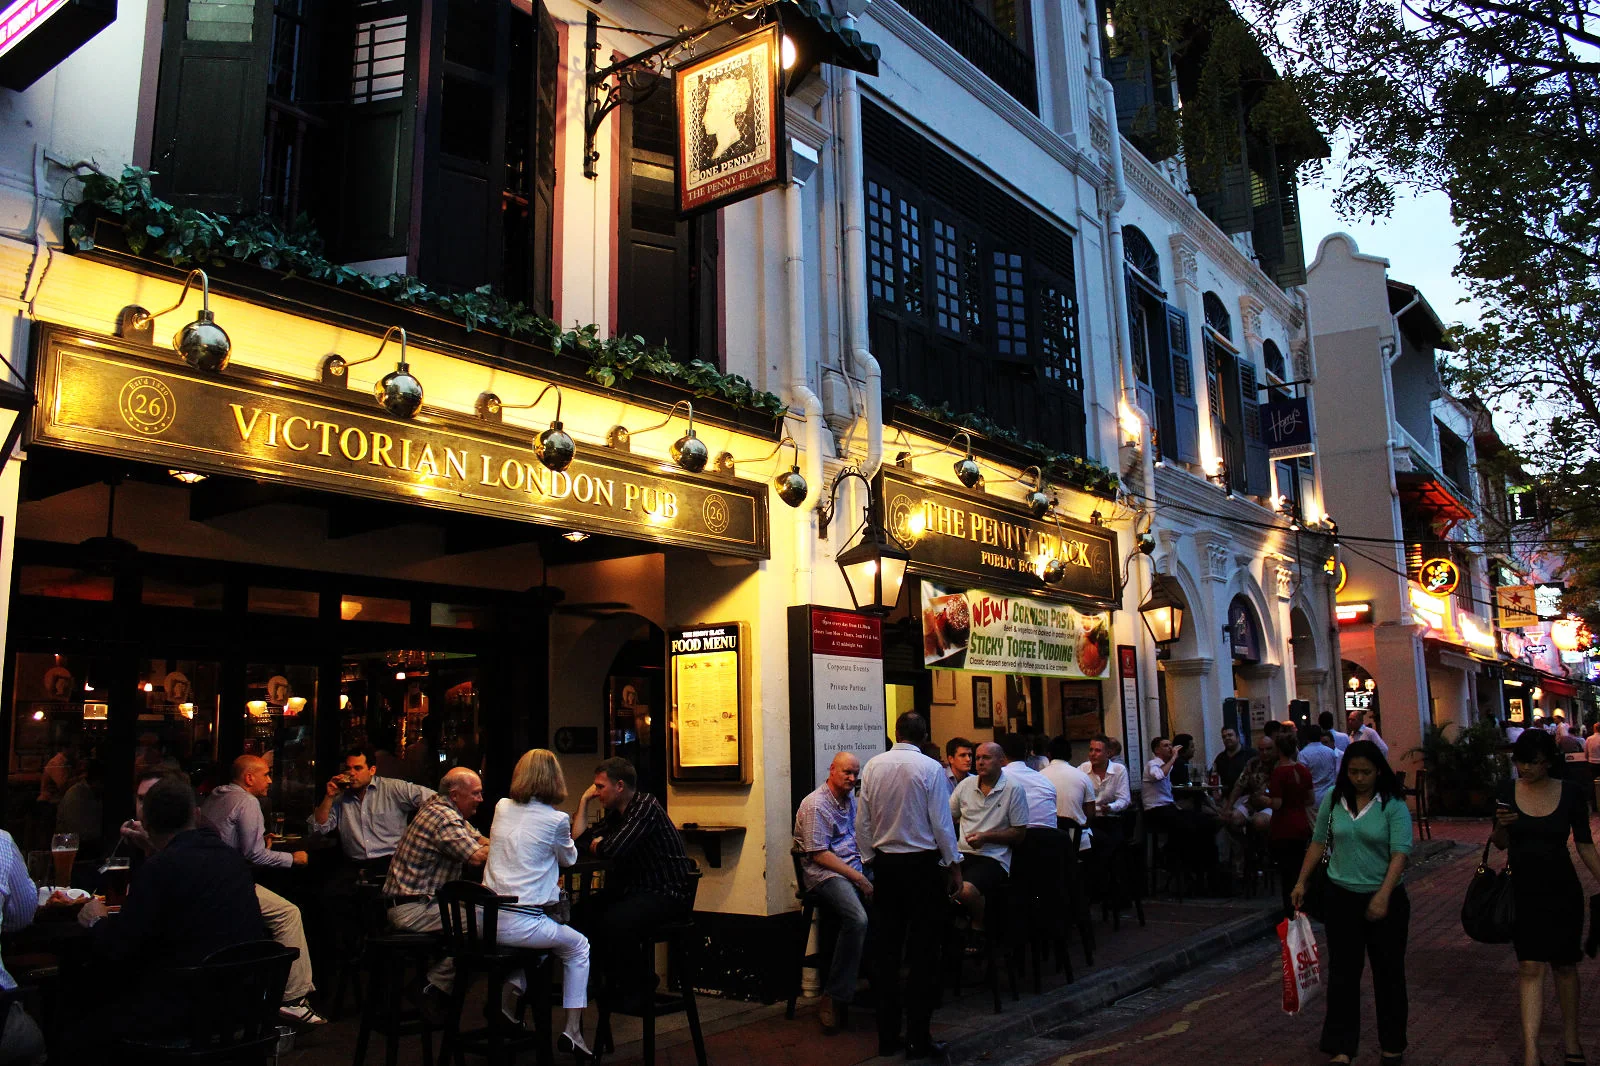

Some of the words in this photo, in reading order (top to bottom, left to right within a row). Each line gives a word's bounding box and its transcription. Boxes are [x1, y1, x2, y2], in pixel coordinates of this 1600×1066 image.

[702, 56, 750, 82] POSTAGE
[700, 164, 719, 180] ONE
[688, 185, 705, 201] THE
[707, 176, 737, 193] PENNY
[739, 163, 771, 181] BLACK
[135, 394, 160, 416] 26
[1269, 408, 1302, 442] Harry's
[229, 403, 468, 480] VICTORIAN
[480, 454, 614, 507] LONDON
[623, 482, 678, 518] PUB
[710, 506, 722, 521] 26
[923, 500, 965, 539] THE
[969, 512, 1033, 555] PENNY
[1037, 531, 1091, 568] BLACK
[981, 550, 1015, 571] PUBLIC
[972, 597, 1009, 629] NEW!
[709, 628, 725, 636] BLACK
[1003, 624, 1013, 632] Beef
[671, 638, 701, 653] FOOD
[703, 635, 736, 650] MENU
[970, 632, 1003, 656] STICKY
[1007, 635, 1037, 659] TOFFEE
[1038, 640, 1073, 663] PUDDING
[827, 663, 851, 672] Corporate
[853, 664, 870, 673] Events
[969, 656, 984, 666] Classic
[986, 658, 1001, 667] dessert
[1001, 659, 1016, 668] served
[1023, 661, 1034, 670] toffee
[830, 683, 848, 691] Private
[849, 684, 866, 692] Parties
[826, 702, 836, 710] Hot
[837, 703, 858, 711] Lunches
[860, 704, 872, 712] Daily
[816, 722, 829, 731] Snug
[846, 724, 863, 732] Lounge
[864, 724, 882, 732] Upstairs
[824, 743, 836, 751] Live
[837, 743, 853, 751] Sports
[854, 742, 877, 750] Telecasts
